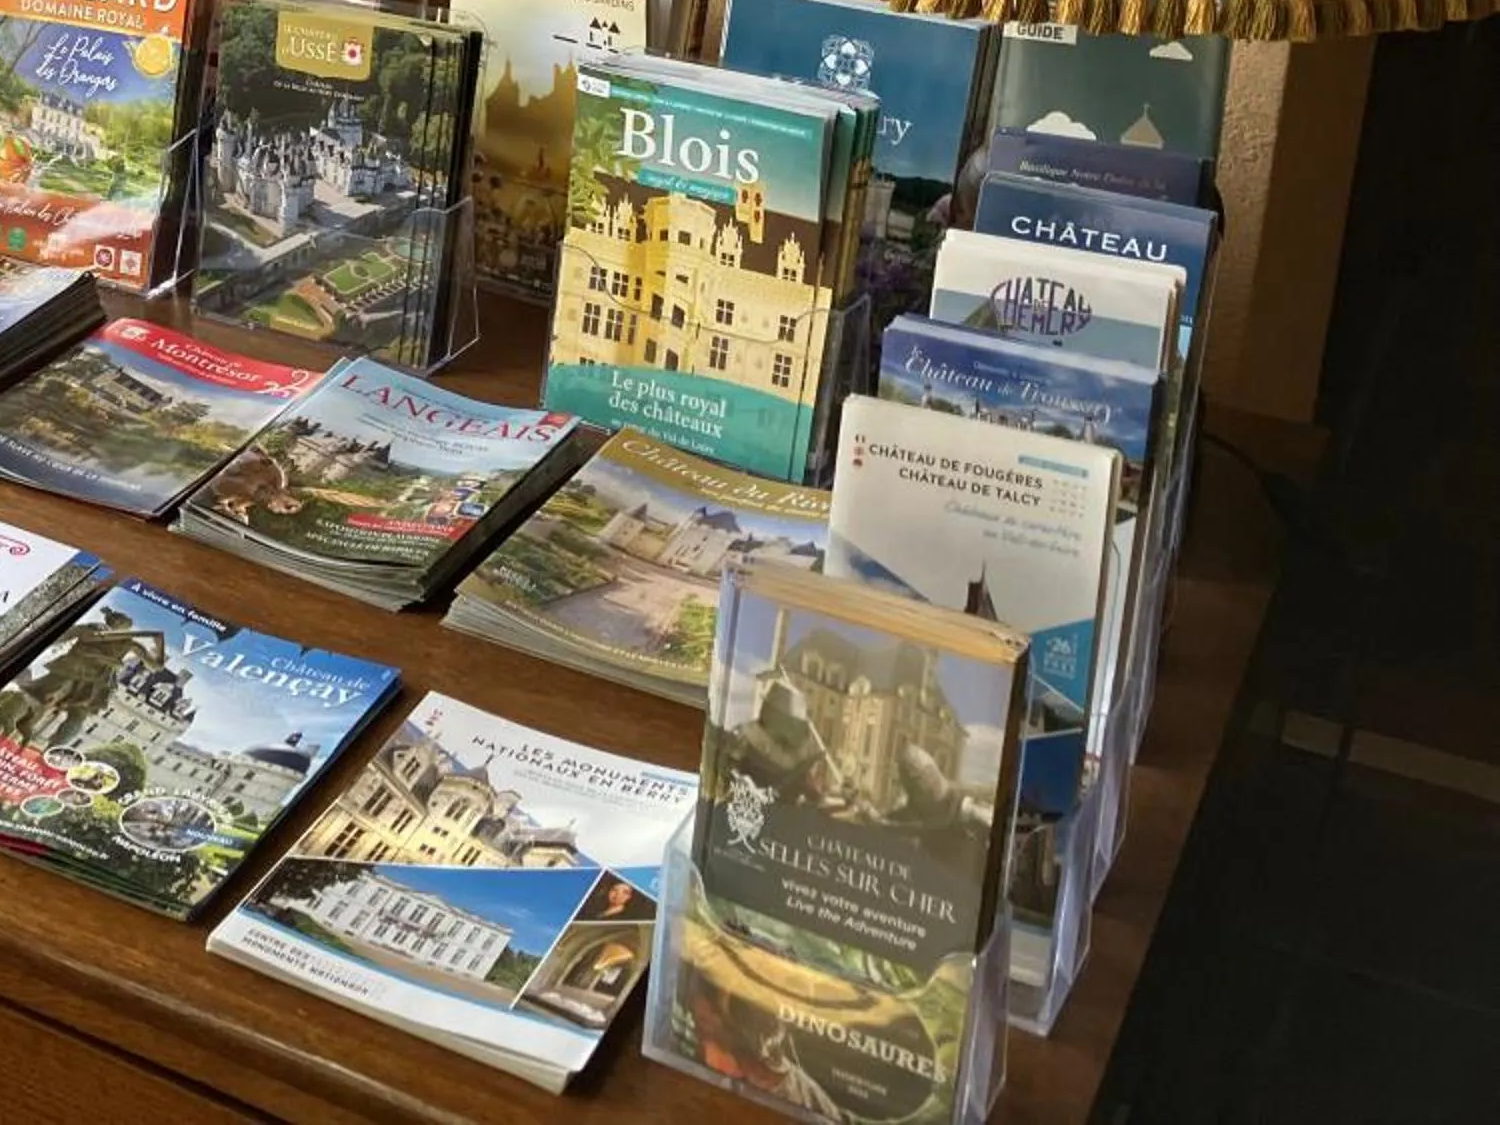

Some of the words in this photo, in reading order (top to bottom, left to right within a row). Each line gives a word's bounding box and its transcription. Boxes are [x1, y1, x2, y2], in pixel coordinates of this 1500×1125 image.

[96, 8, 145, 30] ROYAL
[1017, 23, 1065, 40] GUIDE
[67, 36, 114, 66] Palais
[615, 106, 761, 185] Blois
[1010, 215, 1168, 263] CHÂTEAU
[150, 338, 263, 383] Montrésor
[903, 355, 994, 393] Château
[339, 373, 556, 444] LANGEAIS
[608, 391, 640, 414] des
[642, 402, 724, 439] châteaux
[611, 370, 635, 391] Le
[637, 380, 676, 403] plus
[679, 391, 727, 418] royal
[621, 438, 729, 490] Château
[733, 482, 771, 501] du
[868, 441, 936, 468] CHÂTEAU
[939, 456, 961, 473] DE
[897, 465, 968, 492] CHÂTEAU
[970, 480, 991, 496] DE
[995, 484, 1042, 507] TALCY
[145, 588, 171, 607] vivre
[172, 601, 186, 614] en
[186, 604, 228, 633] famille
[179, 632, 363, 711] Valençay
[269, 653, 343, 685] Château
[345, 673, 371, 693] de
[471, 733, 583, 783] NATIONAUX
[586, 771, 615, 790] EN
[619, 779, 684, 806] BERRY
[520, 741, 560, 764] LES
[565, 754, 691, 799] MONUMENTS
[185, 826, 234, 847] NOUVEAU
[758, 837, 832, 877] SELLES
[835, 862, 881, 898] SUR
[890, 882, 958, 925] CHER
[821, 890, 861, 914] votre
[786, 895, 815, 915] Live
[818, 906, 842, 924] the
[844, 916, 918, 952] Adventure
